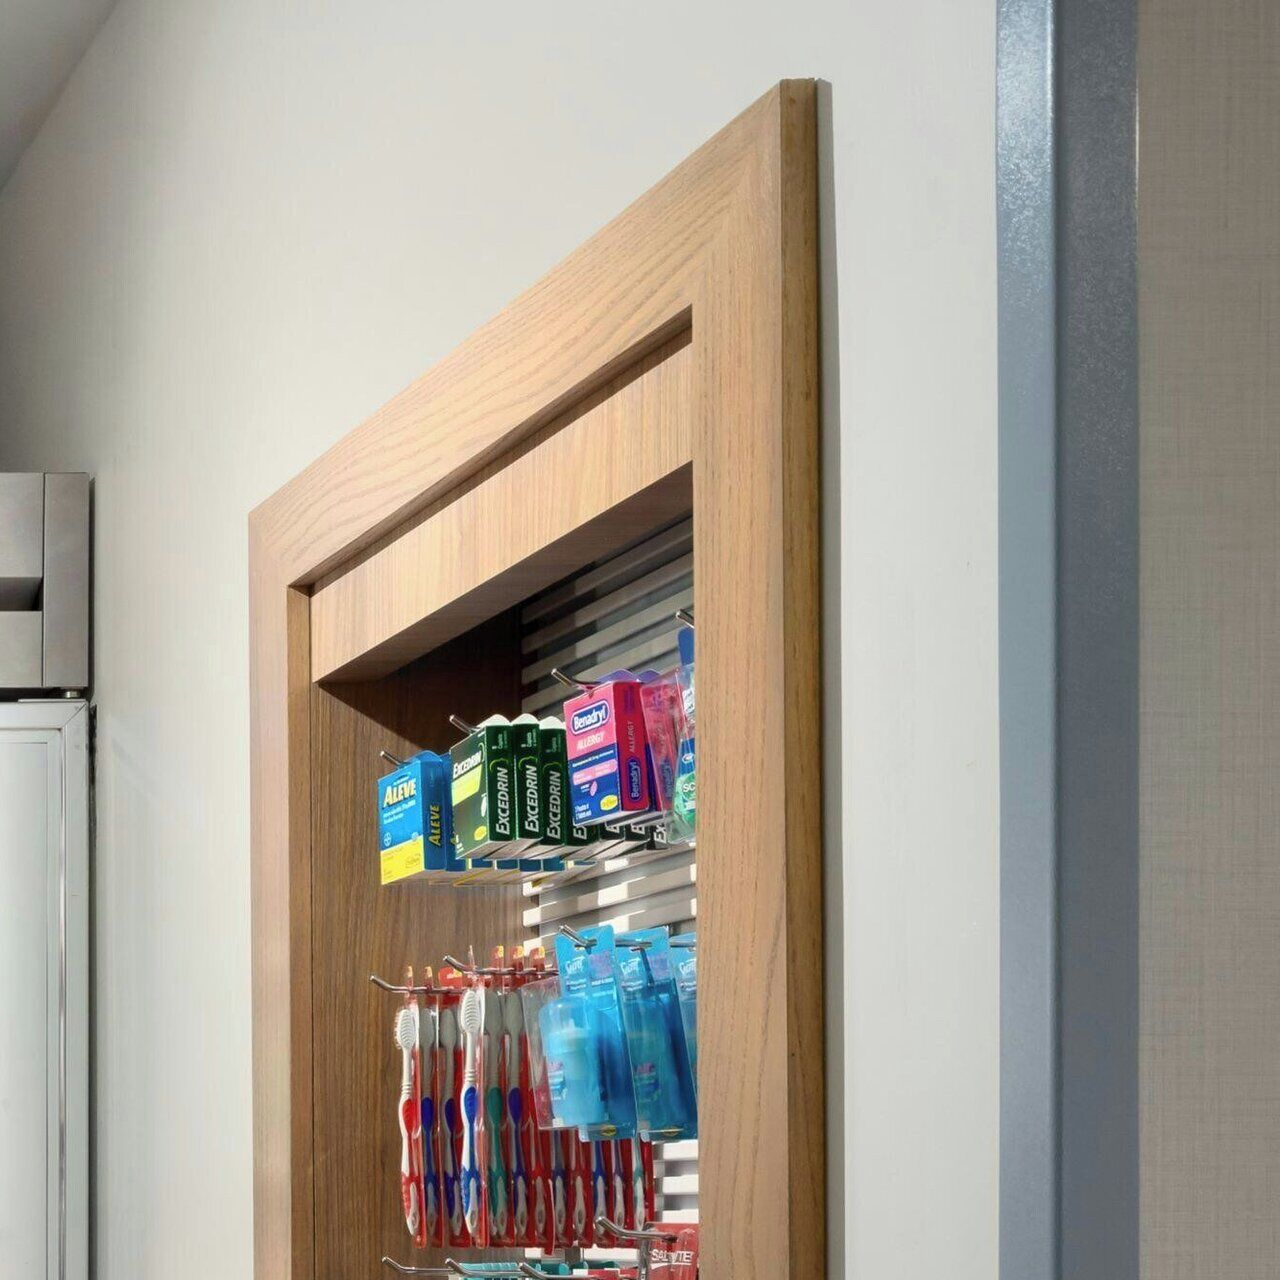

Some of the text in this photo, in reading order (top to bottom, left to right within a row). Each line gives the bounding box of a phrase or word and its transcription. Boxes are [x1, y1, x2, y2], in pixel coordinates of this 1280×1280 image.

[572, 704, 608, 729] Benadryl
[576, 732, 605, 750] ALLERGY
[383, 778, 417, 808] ALEVE
[525, 765, 539, 833] EXCEDRIN
[631, 761, 641, 799] Benadryl
[495, 767, 510, 836] EXCEDRIN
[547, 771, 561, 840] EXCEDRIN
[428, 804, 441, 846] ALEVE
